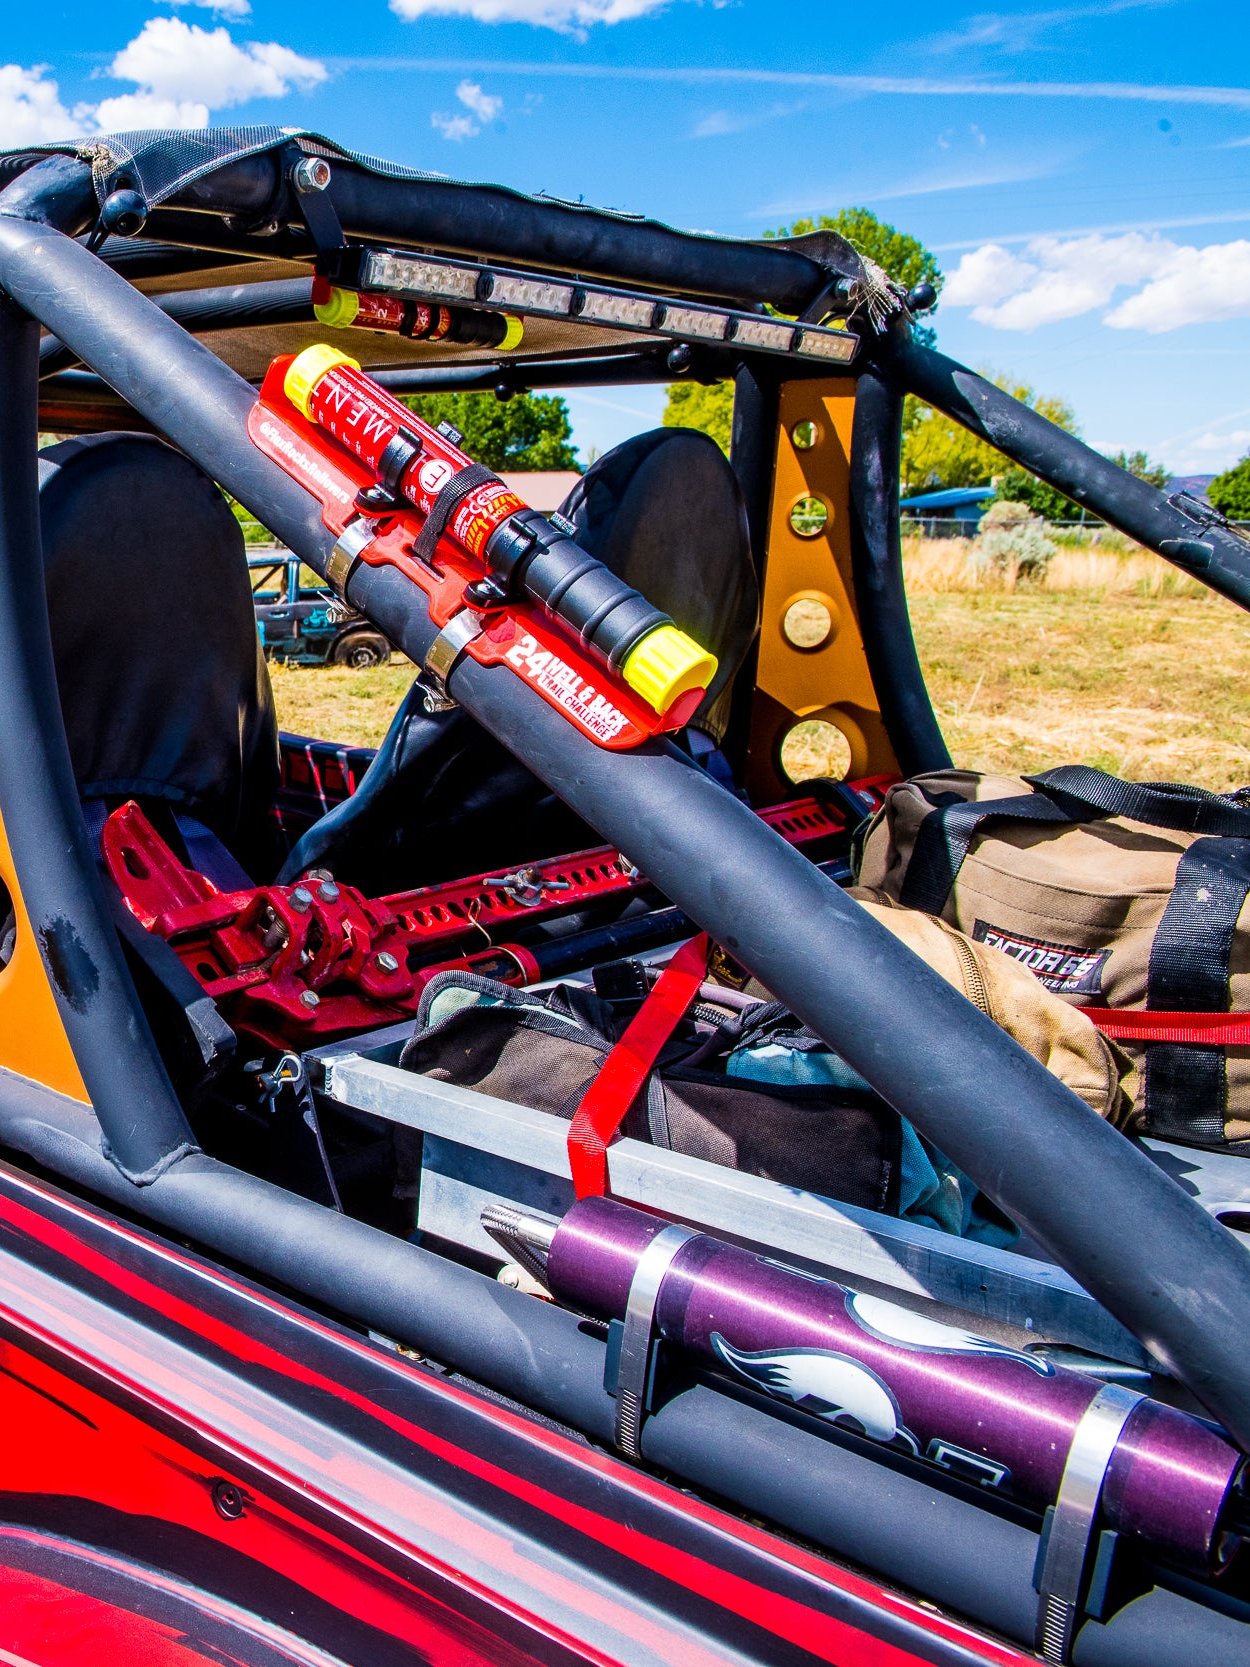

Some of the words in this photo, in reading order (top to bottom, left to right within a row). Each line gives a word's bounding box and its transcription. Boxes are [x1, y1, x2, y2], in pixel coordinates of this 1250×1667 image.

[329, 369, 357, 394] PROTECTION
[353, 390, 367, 402] FIRE
[363, 399, 391, 420] ADVANCED
[259, 421, 351, 505] @FlexRocksRollovers
[490, 504, 510, 520] HOT!
[505, 634, 553, 677] 24
[578, 686, 596, 705] &
[588, 693, 630, 734] BACK
[541, 673, 565, 701] TRAIL
[564, 695, 611, 738] CHALLENGE
[983, 932, 1065, 972] FACTOR
[1058, 955, 1100, 977] 55
